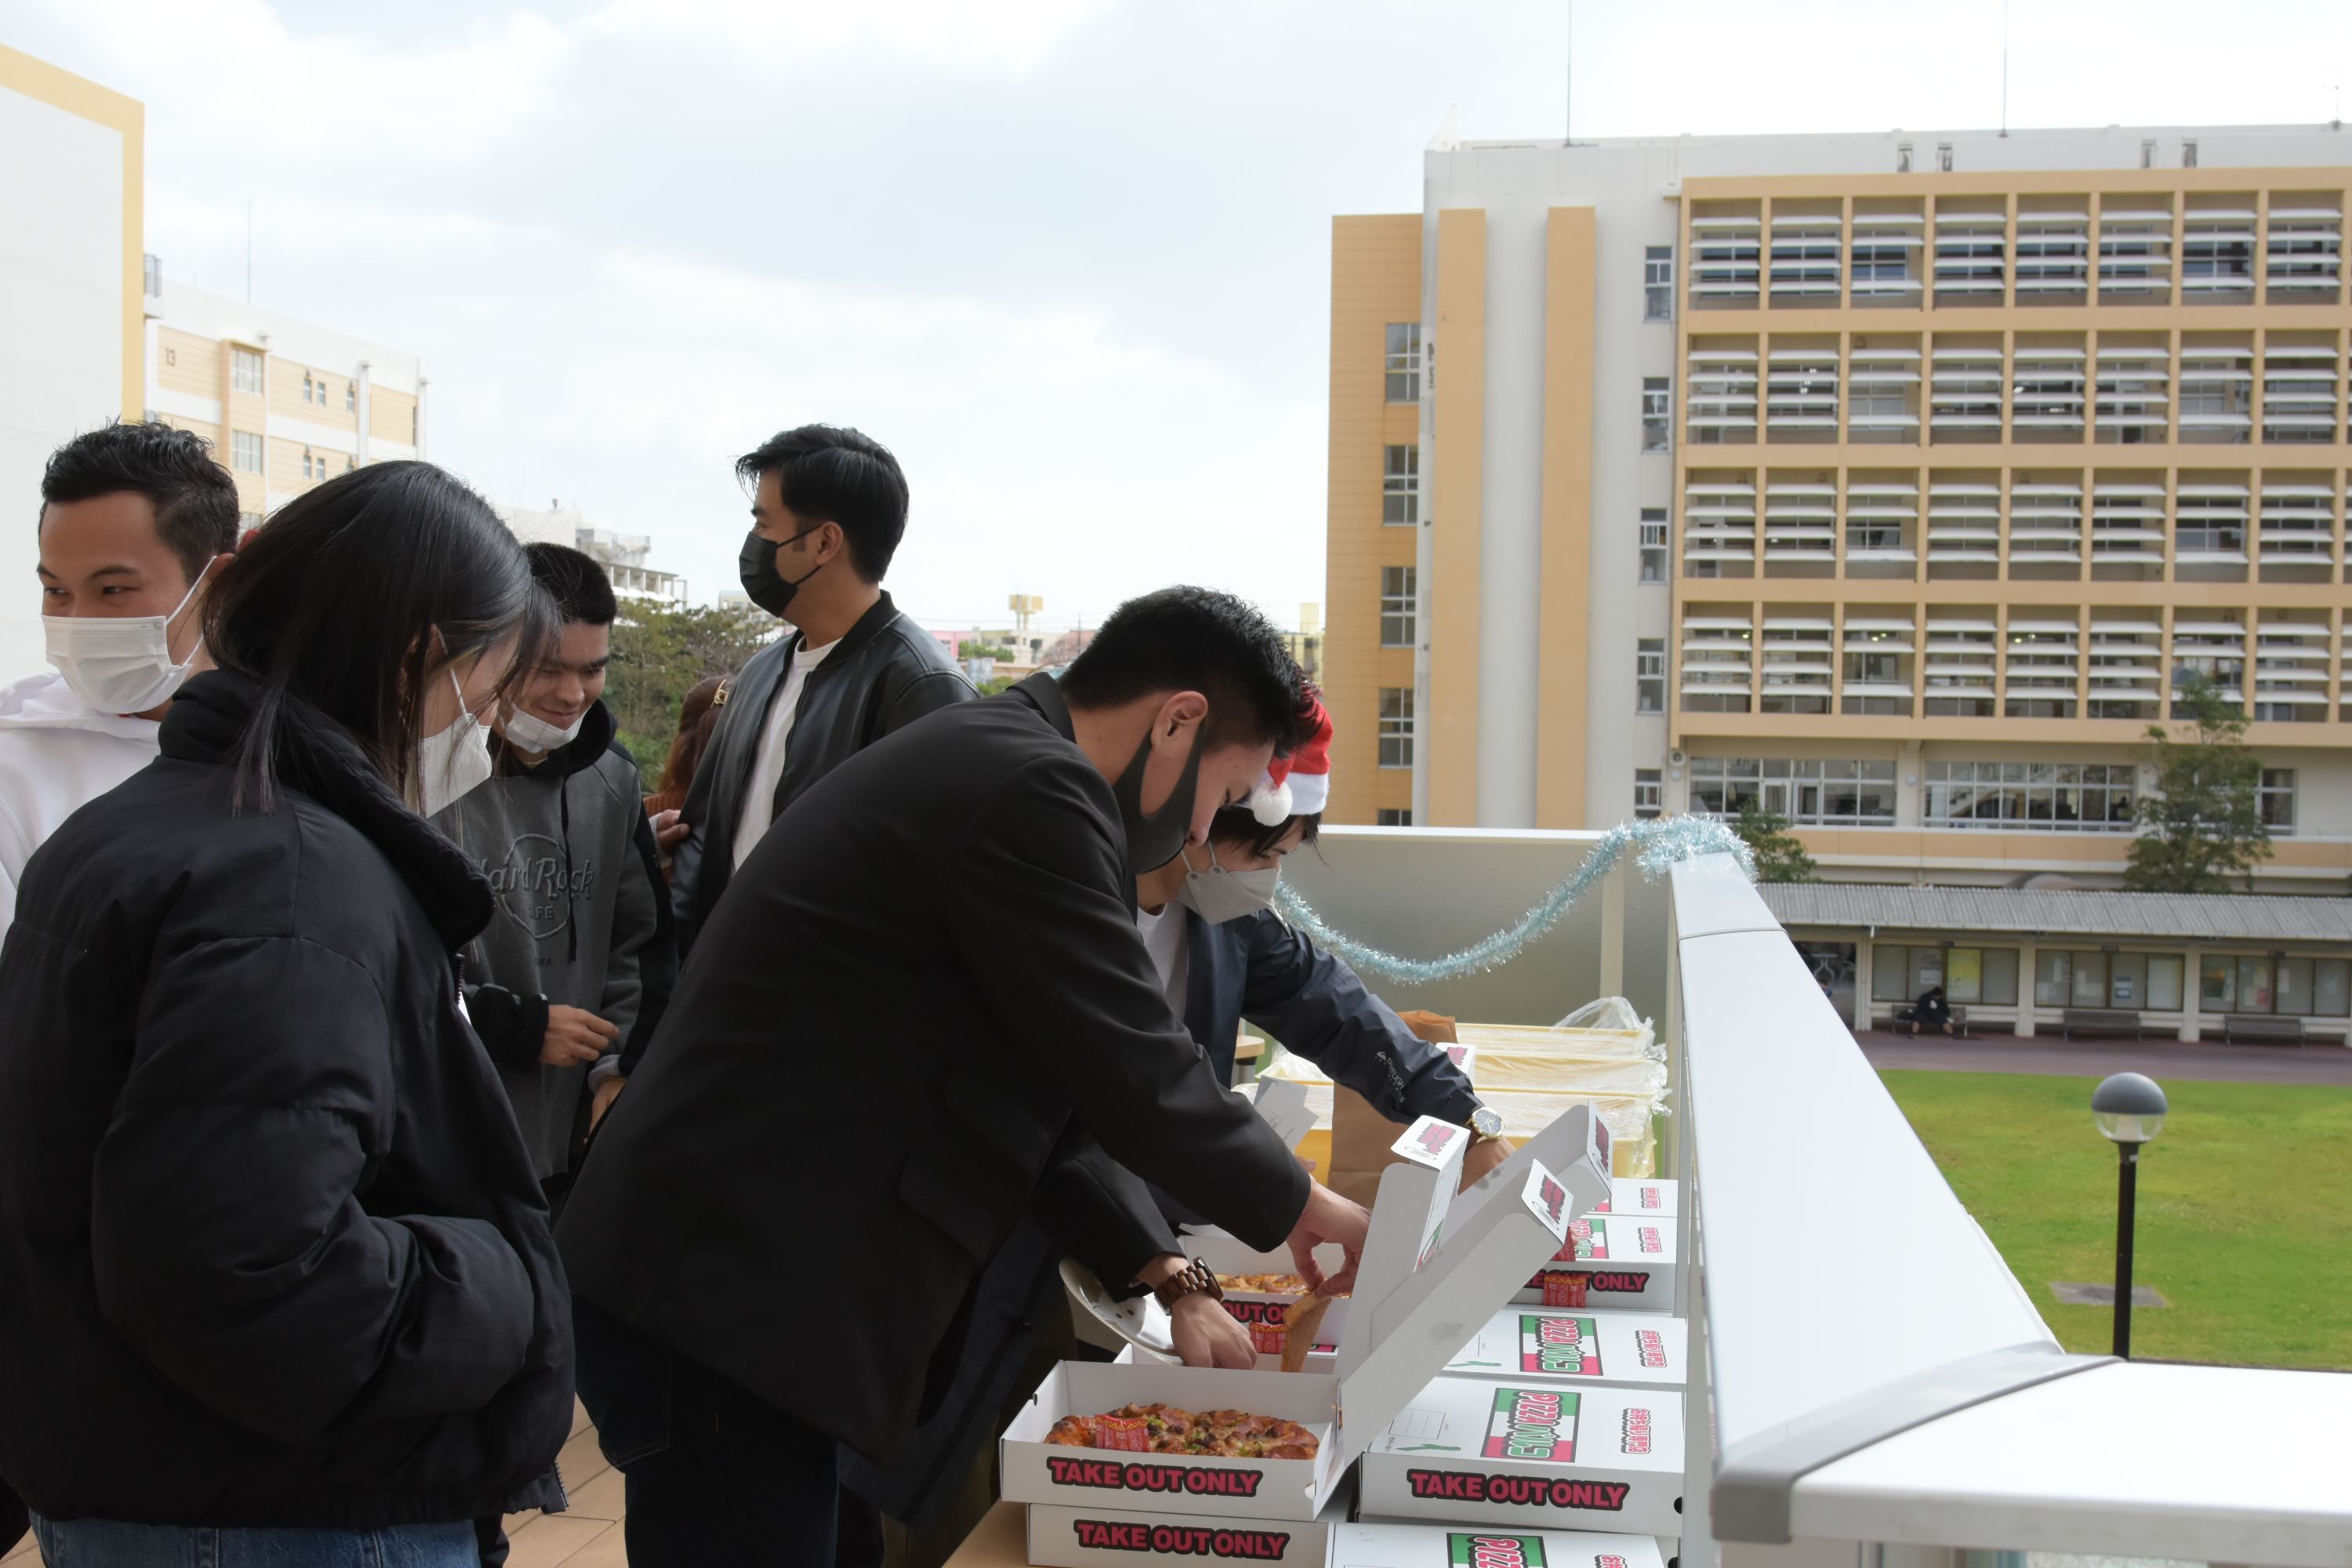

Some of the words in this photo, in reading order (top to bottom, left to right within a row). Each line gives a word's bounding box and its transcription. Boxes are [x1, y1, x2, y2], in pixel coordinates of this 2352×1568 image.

[165, 347, 176, 367] 13
[535, 858, 595, 899] Rock
[1592, 1272, 1647, 1292] ONLY
[1622, 1408, 1651, 1454] お持ち帰り専門店
[1048, 1458, 1122, 1487] TAKE
[1124, 1465, 1185, 1490] OUT
[1185, 1469, 1261, 1495] ONLY
[1409, 1472, 1485, 1500] TAKE
[1487, 1476, 1550, 1504] OUT
[1550, 1480, 1628, 1509] ONLY
[1076, 1521, 1149, 1549] TAKE
[1152, 1527, 1211, 1554] OUT
[1214, 1531, 1288, 1559] ONLY
